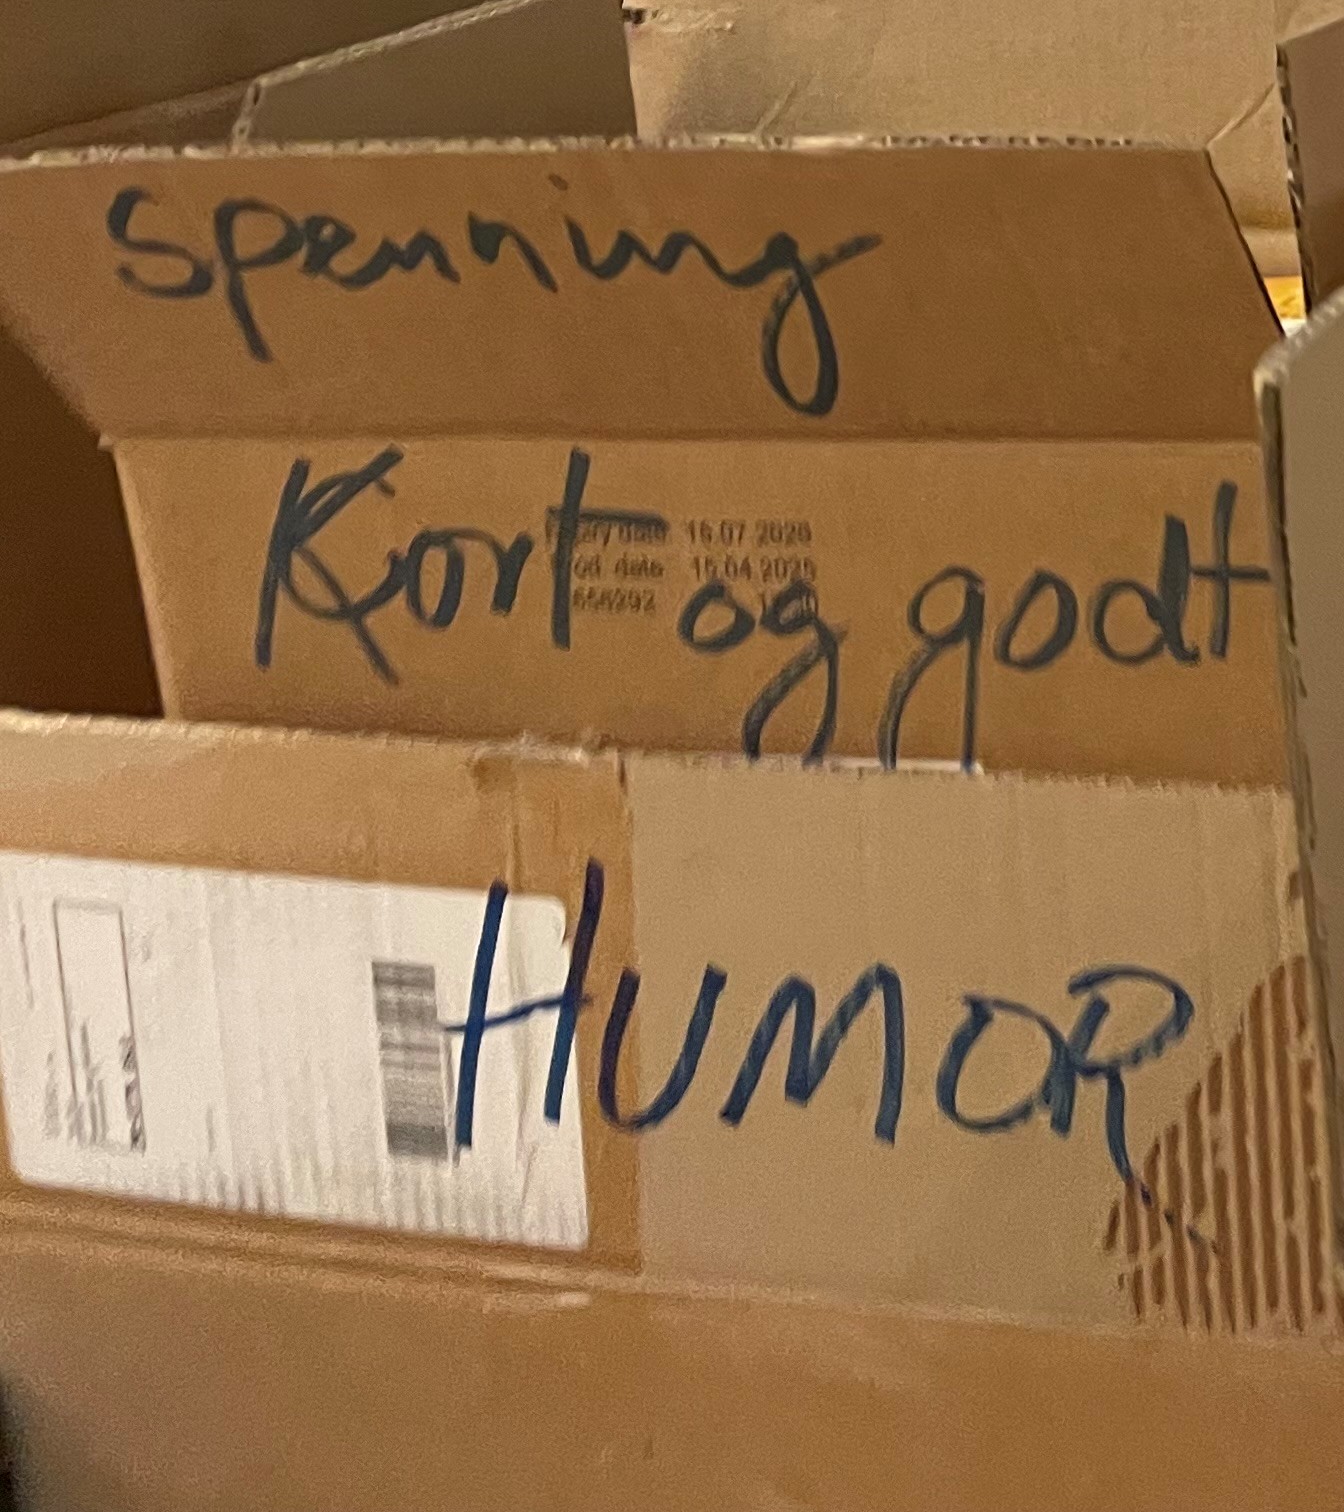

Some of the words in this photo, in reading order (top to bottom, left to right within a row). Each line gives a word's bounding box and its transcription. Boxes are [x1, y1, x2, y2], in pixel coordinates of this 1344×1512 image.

[106, 174, 884, 418] Spenning
[253, 445, 672, 685] Kort
[677, 565, 850, 765] og
[876, 480, 1271, 774] godt
[443, 858, 1210, 1228] HUMOR
